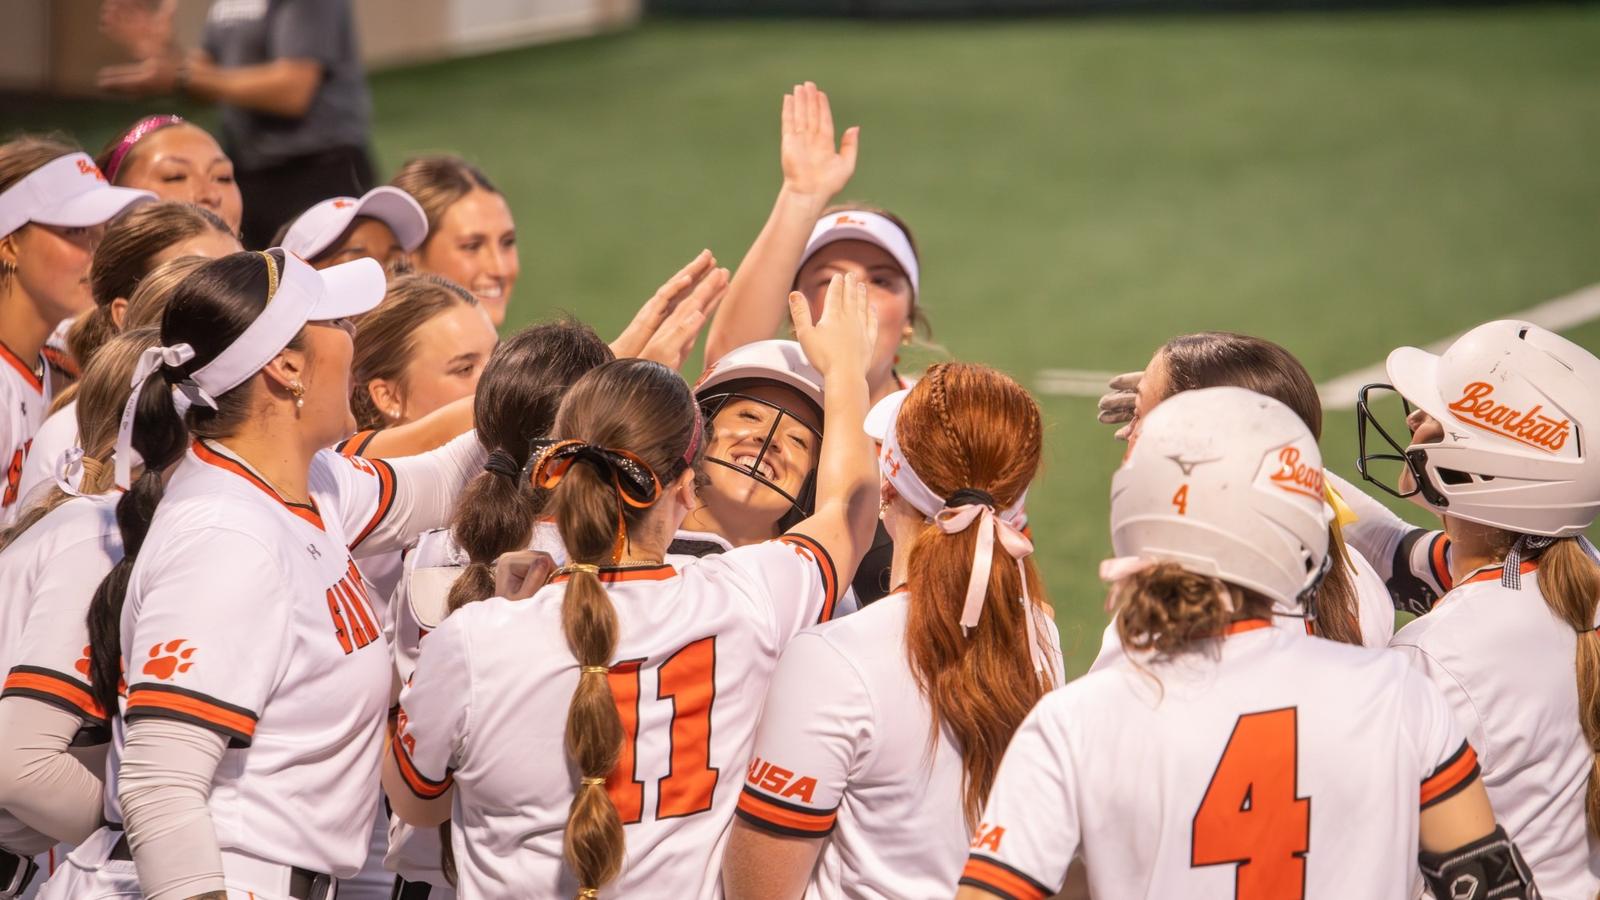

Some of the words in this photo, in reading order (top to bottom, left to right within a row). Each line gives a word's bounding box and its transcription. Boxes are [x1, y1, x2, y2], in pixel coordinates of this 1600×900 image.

[1448, 382, 1570, 453] Bearkats
[1172, 484, 1188, 515] 4
[747, 757, 818, 804] USA
[1190, 705, 1312, 900] 4
